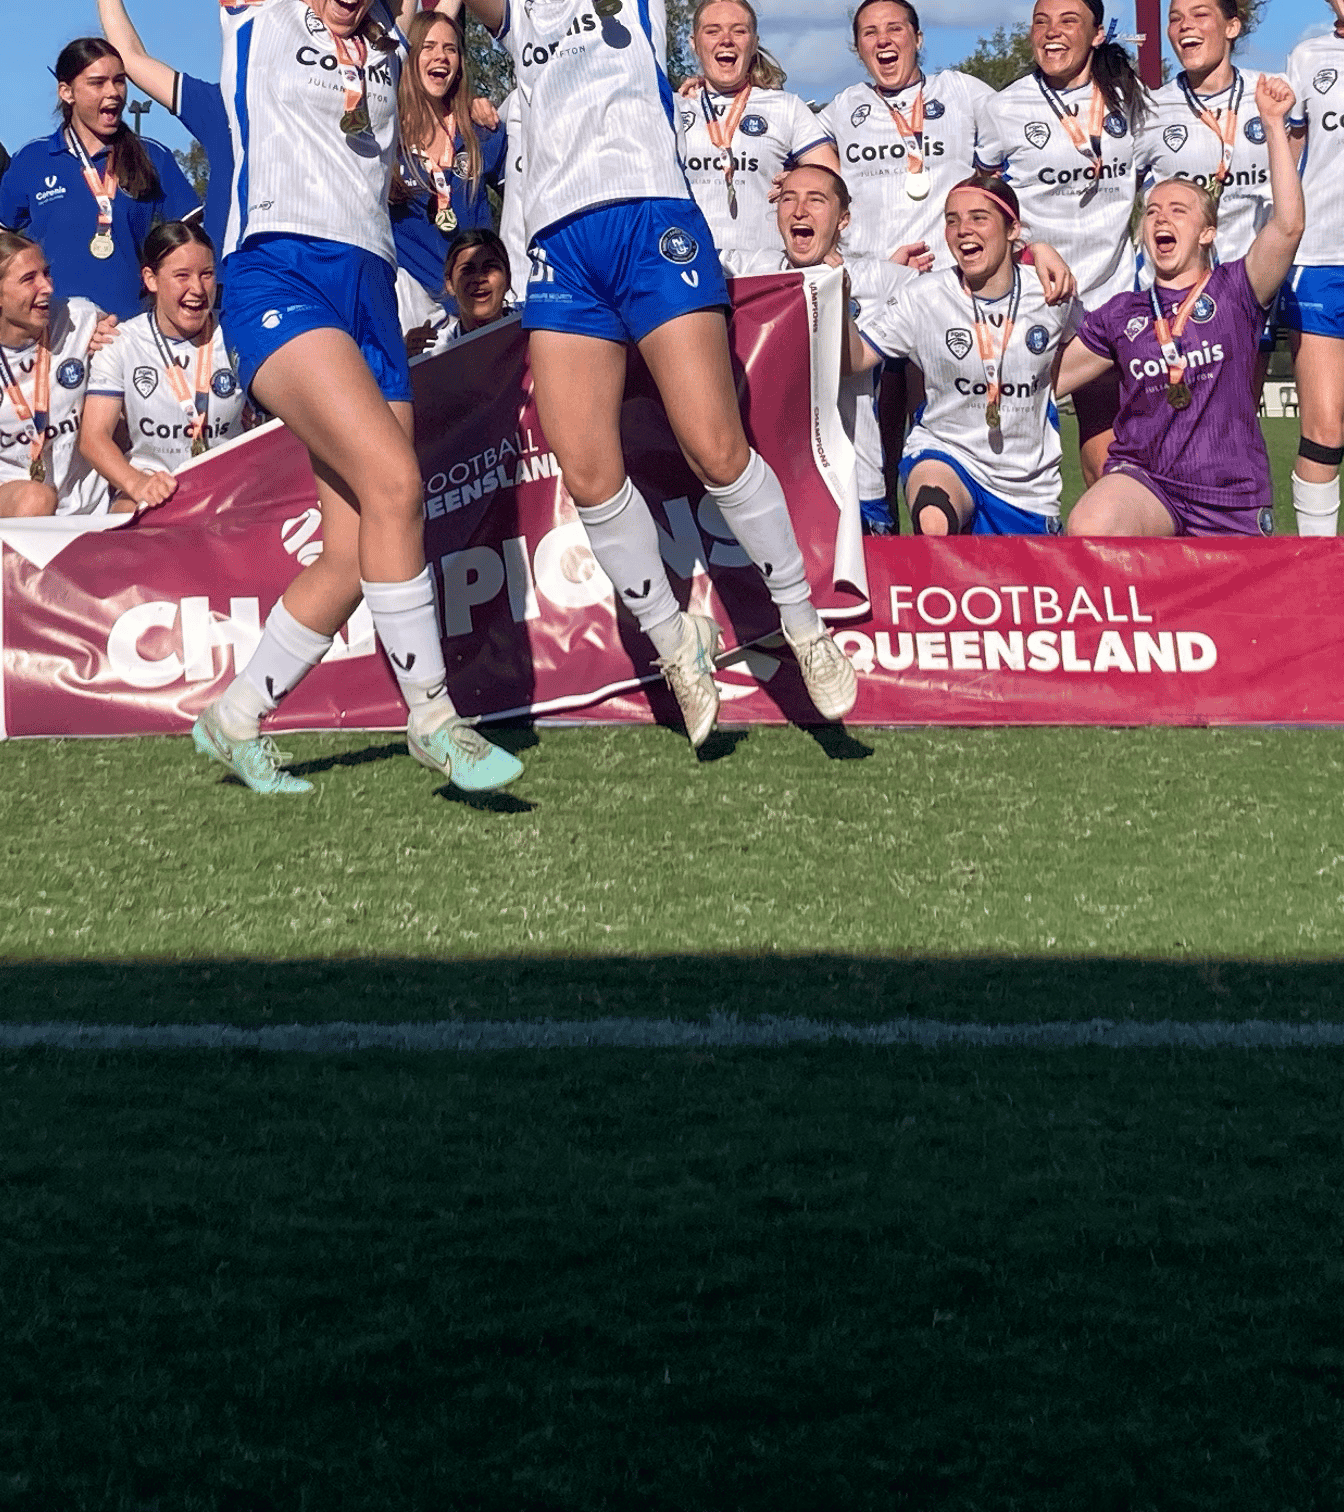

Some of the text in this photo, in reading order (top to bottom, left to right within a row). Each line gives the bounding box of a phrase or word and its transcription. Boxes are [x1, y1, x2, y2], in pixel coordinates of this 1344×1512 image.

[845, 135, 945, 164] Corois
[813, 405, 831, 469] CHAMPIONS
[425, 428, 539, 493] OOTBALL
[890, 585, 1154, 627] FOOTBALL
[834, 630, 1217, 675] QUEENSLAND
